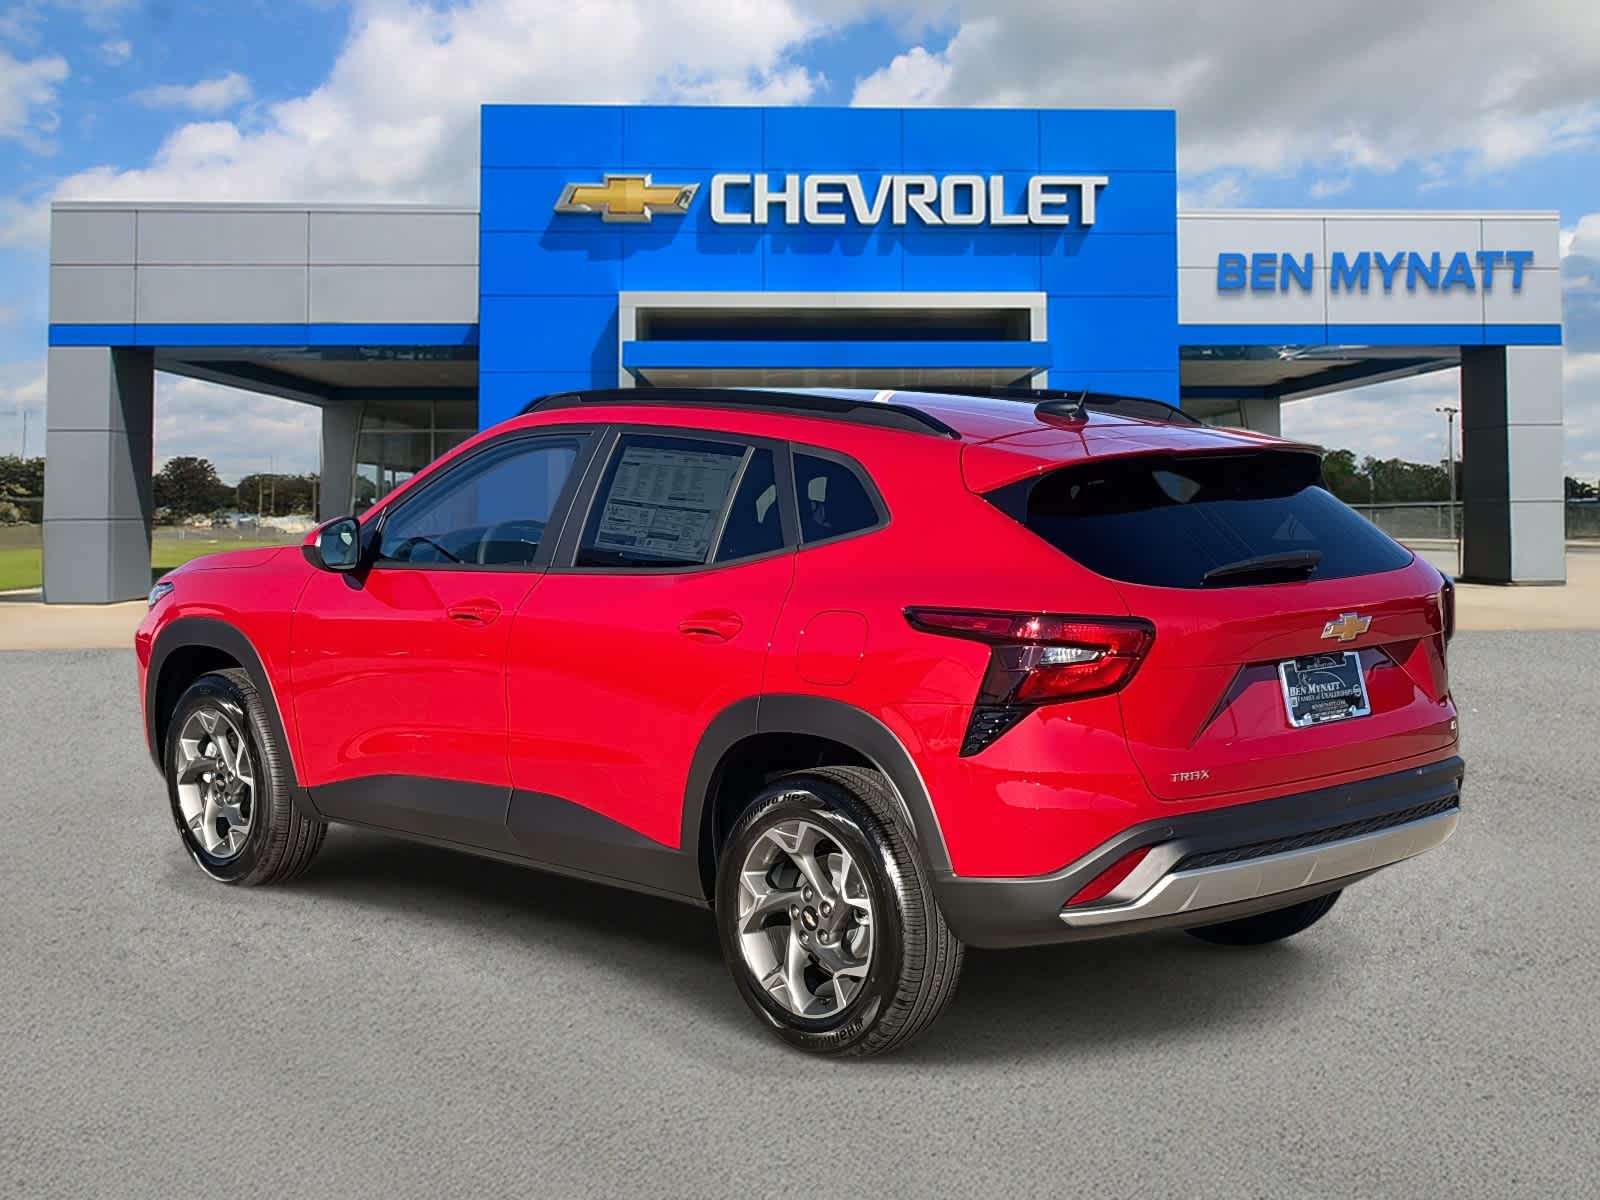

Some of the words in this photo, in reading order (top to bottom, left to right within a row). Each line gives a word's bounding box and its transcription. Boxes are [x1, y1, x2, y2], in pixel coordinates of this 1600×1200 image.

[710, 173, 1109, 225] CHEVROLET
[1217, 252, 1313, 289] BEN
[1330, 250, 1534, 289] MYNATT
[1290, 686, 1308, 697] BEN
[1308, 682, 1341, 695] MYNATT
[1169, 769, 1210, 783] TRAX
